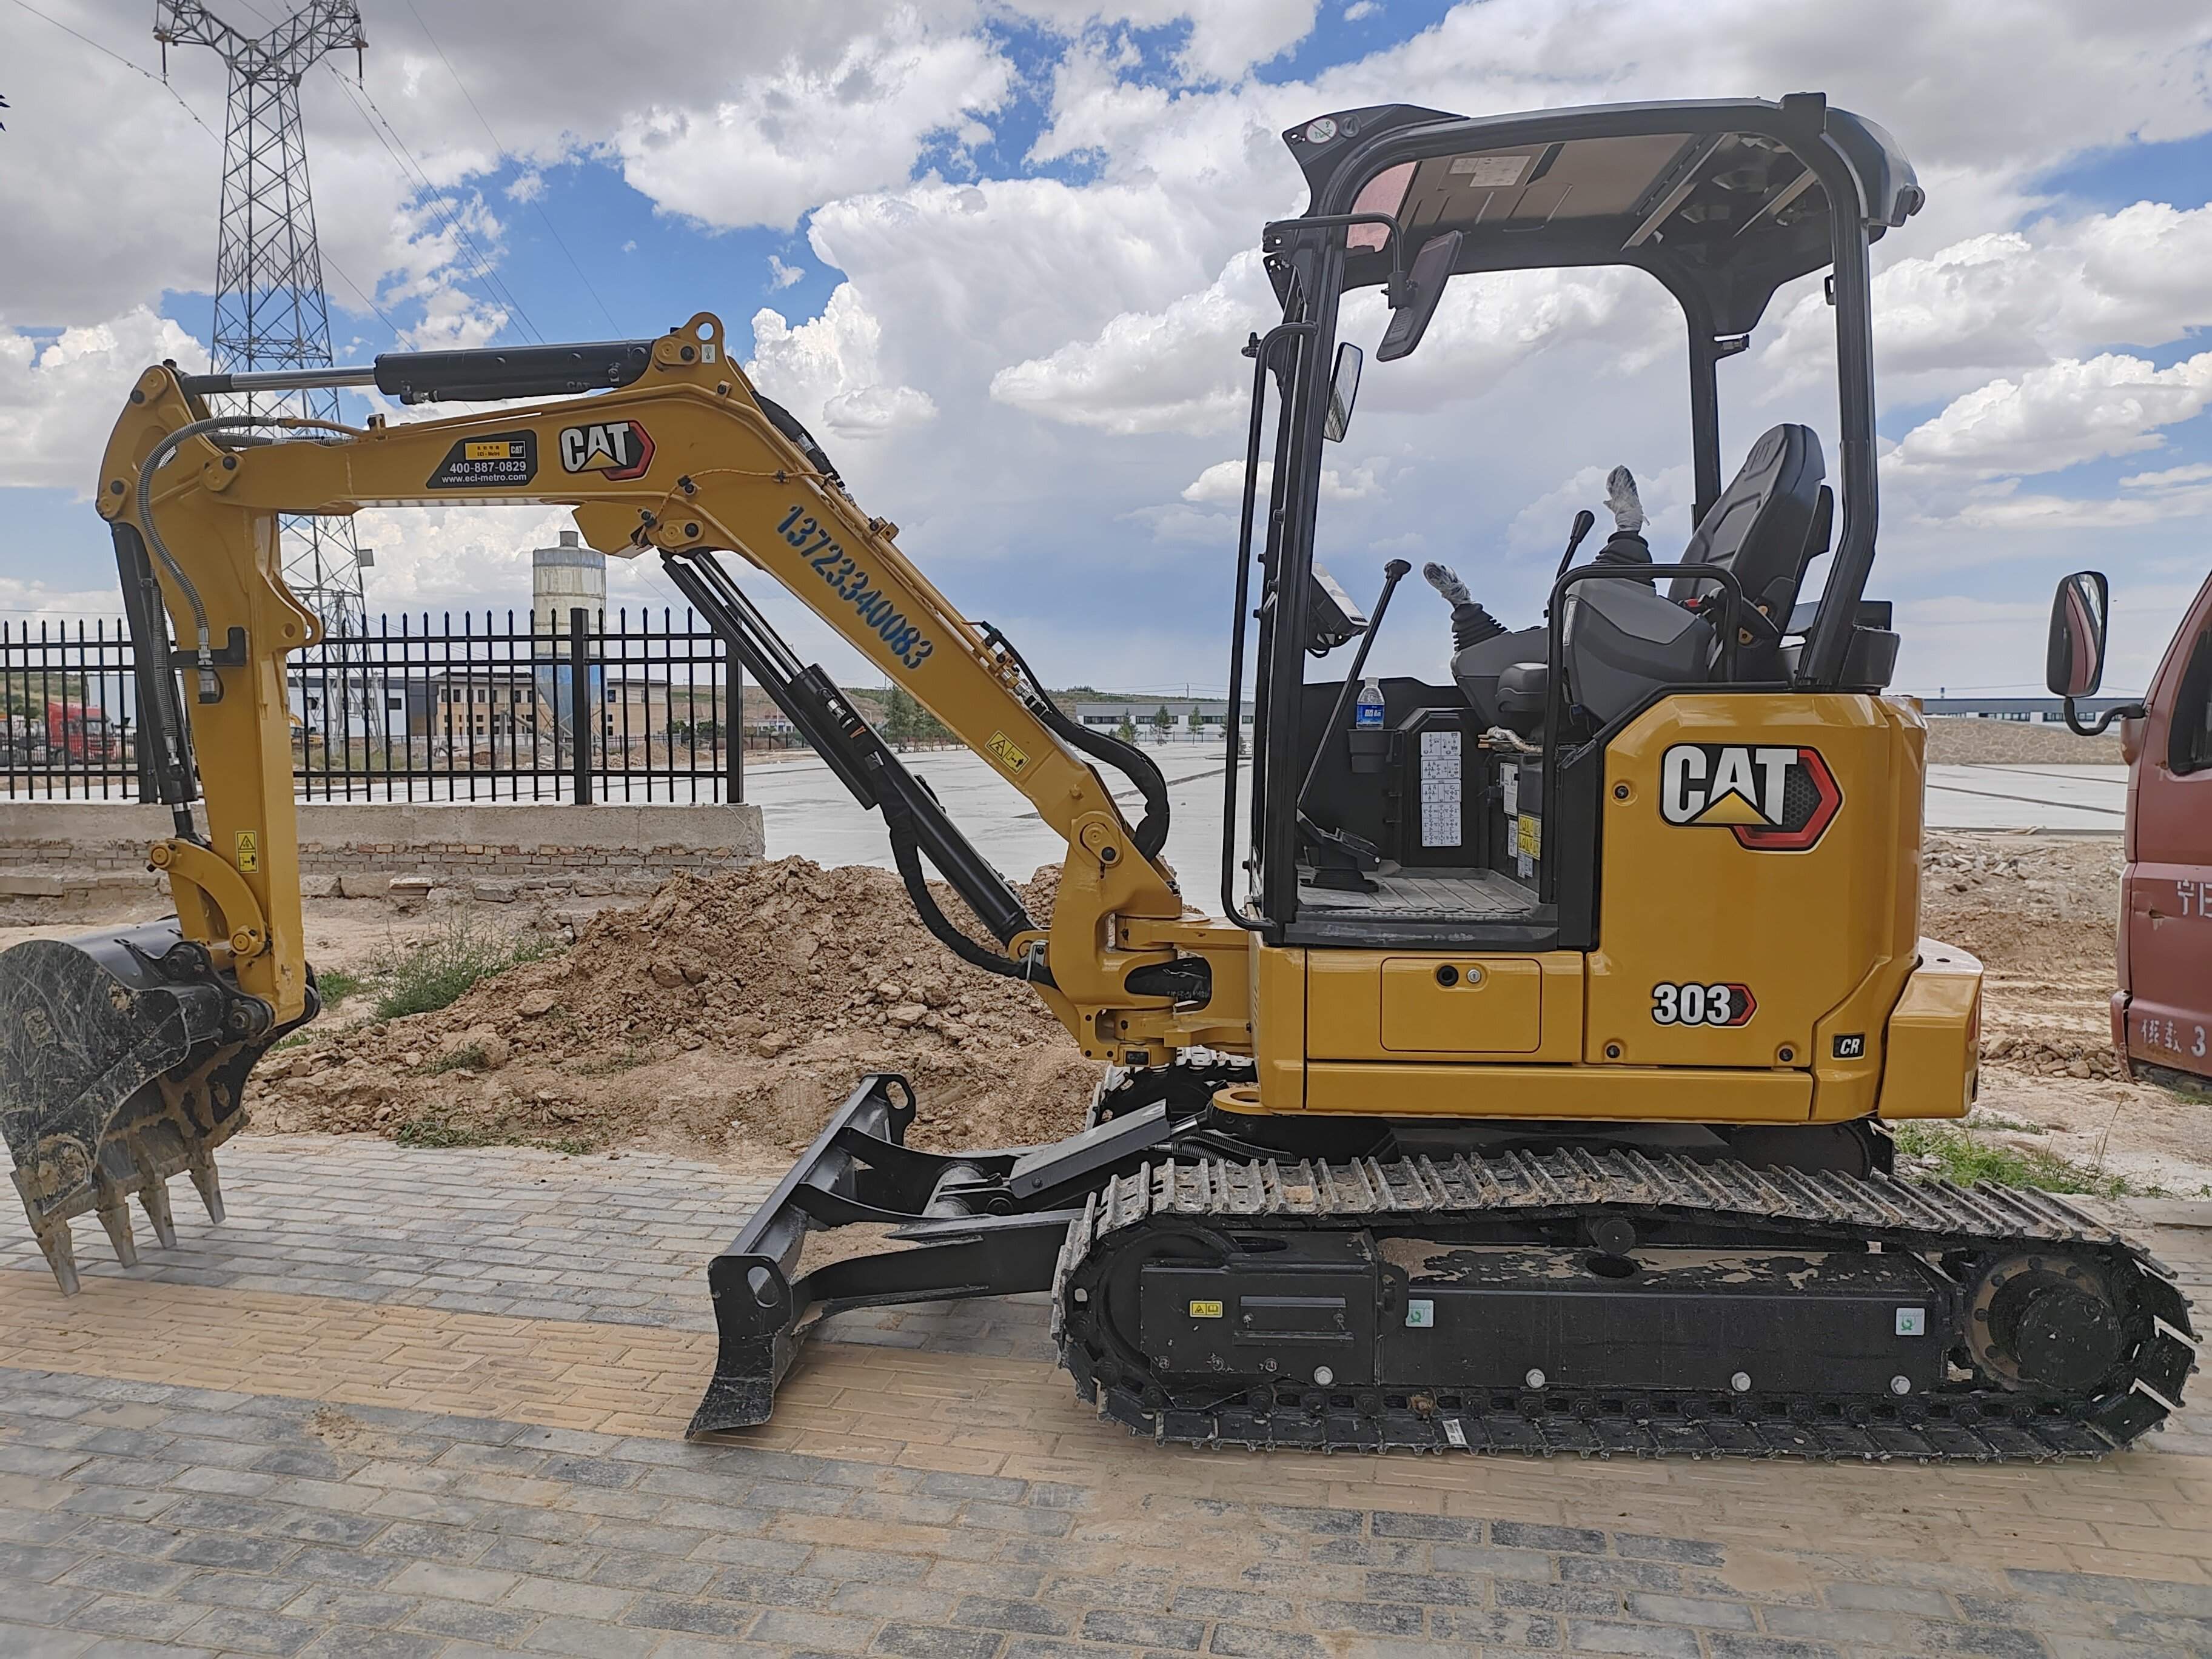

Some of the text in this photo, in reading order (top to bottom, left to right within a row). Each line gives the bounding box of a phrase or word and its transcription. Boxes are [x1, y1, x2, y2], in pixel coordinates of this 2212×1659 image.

[511, 446, 523, 454] CAT
[560, 421, 629, 472] CAT
[449, 461, 526, 474] 400-887-0829
[777, 506, 933, 669] 13723340083
[1663, 745, 1798, 825] CAT
[1653, 984, 1731, 1024] 303
[1840, 1038, 1860, 1054] CR
[2191, 1025, 2206, 1057] 3
